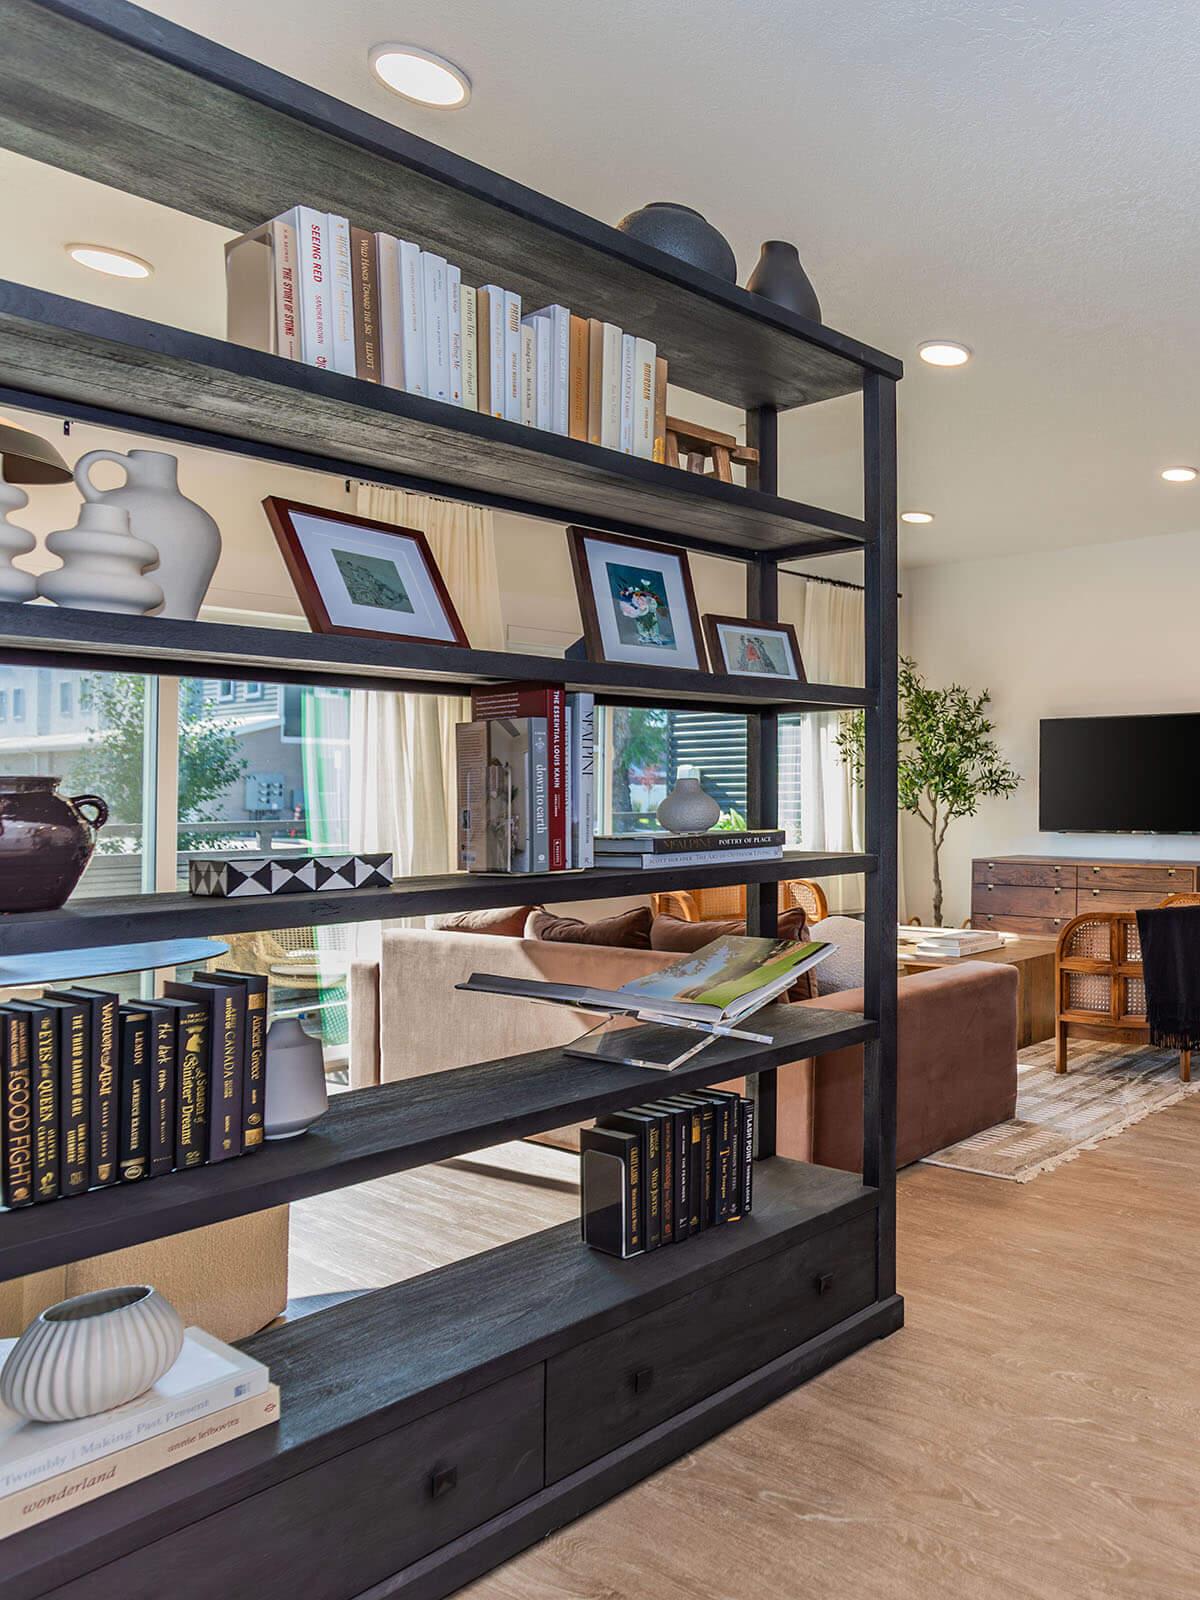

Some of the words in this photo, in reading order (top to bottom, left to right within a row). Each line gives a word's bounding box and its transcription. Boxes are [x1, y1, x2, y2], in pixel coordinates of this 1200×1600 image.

[311, 224, 322, 260] SEEING
[282, 267, 293, 280] THE
[312, 262, 323, 283] RED
[282, 282, 294, 302] STORY
[284, 303, 294, 312] OF
[315, 295, 323, 320] SANDRA
[466, 298, 474, 322] stolen
[511, 303, 519, 333] PROUD
[285, 314, 295, 337] STONE
[316, 321, 324, 345] BROWN
[466, 324, 475, 338] life
[465, 349, 474, 370] jaycee
[465, 371, 475, 395] dugard
[643, 363, 651, 401] BOURDAIN
[535, 764, 547, 793] down
[536, 794, 546, 806] to
[536, 806, 548, 834] earth
[718, 838, 742, 846] POETRY
[72, 1014, 83, 1031] THE
[101, 1001, 113, 1051] WARRIOR
[158, 1022, 174, 1040] the
[252, 1016, 263, 1048] Ancient
[38, 1030, 54, 1062] EYES
[72, 1032, 83, 1057] THIRD
[133, 1030, 144, 1066] LEMON
[158, 1044, 174, 1064] dark
[224, 1031, 236, 1078] CANADA
[72, 1058, 83, 1095] RAINBOW
[250, 1049, 262, 1081] Greece
[132, 1078, 142, 1117] LAWRENCE
[182, 1062, 194, 1104] Sinister
[195, 1079, 208, 1115] Season
[8, 1076, 30, 1132] GOOD
[37, 1080, 55, 1122] QUEEN
[72, 1097, 83, 1118] GIRL
[180, 1104, 194, 1145] Dreams
[745, 1114, 753, 1139] FLASH
[8, 1134, 31, 1186] FIGHT
[80, 1428, 133, 1456] Making
[136, 1416, 163, 1436] Past
[165, 1400, 210, 1422] Present
[167, 1433, 196, 1453] annie
[198, 1416, 240, 1440] leibovitz
[21, 1465, 118, 1516] wonderland
